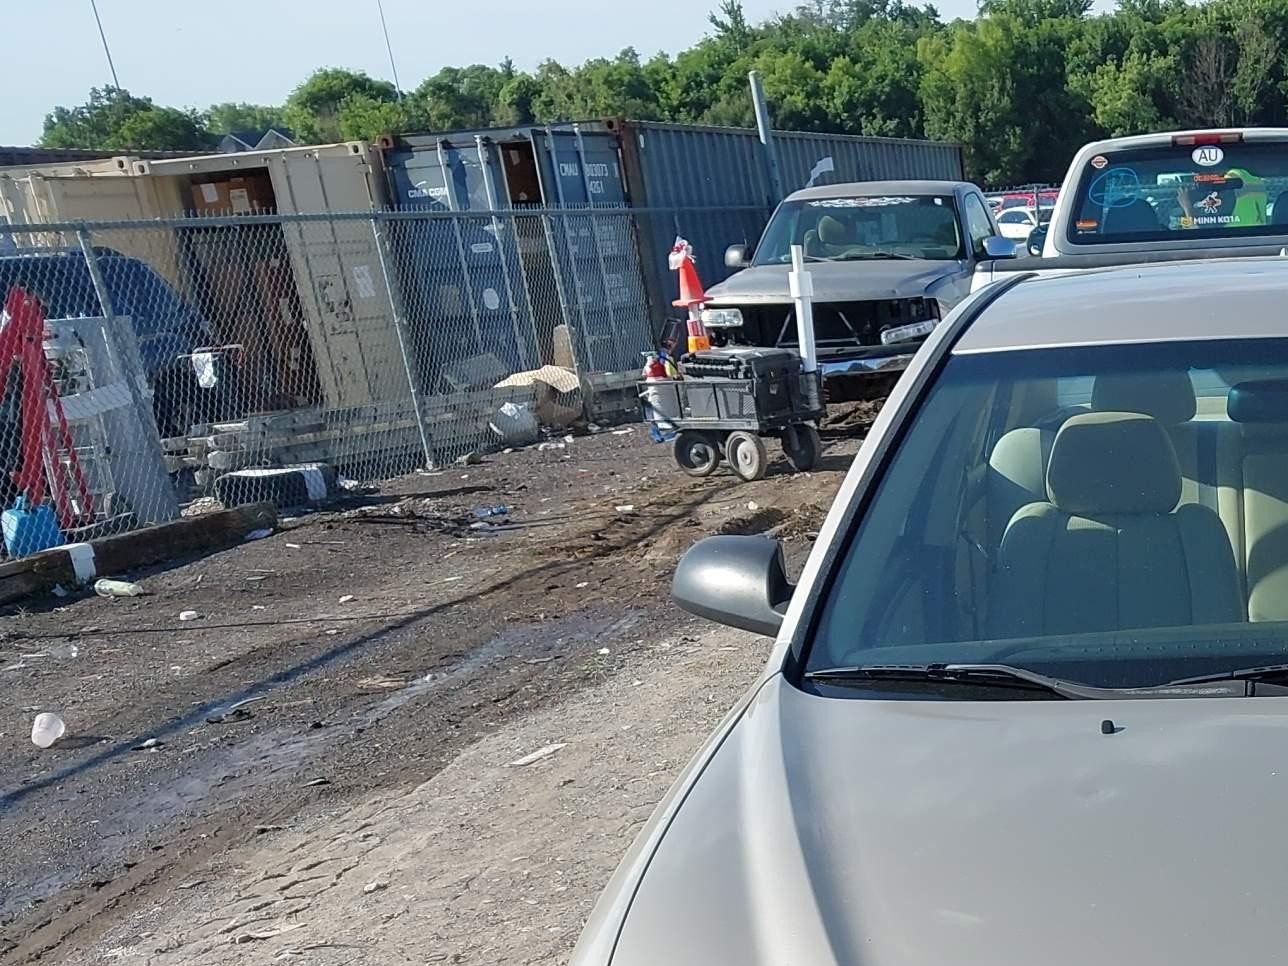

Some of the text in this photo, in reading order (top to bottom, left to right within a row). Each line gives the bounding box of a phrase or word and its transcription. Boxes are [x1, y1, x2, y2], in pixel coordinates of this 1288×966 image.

[1199, 150, 1219, 162] AU
[560, 163, 579, 176] CMAU
[408, 186, 447, 198] CMA CGM
[1193, 215, 1241, 225] MINN KOTA
